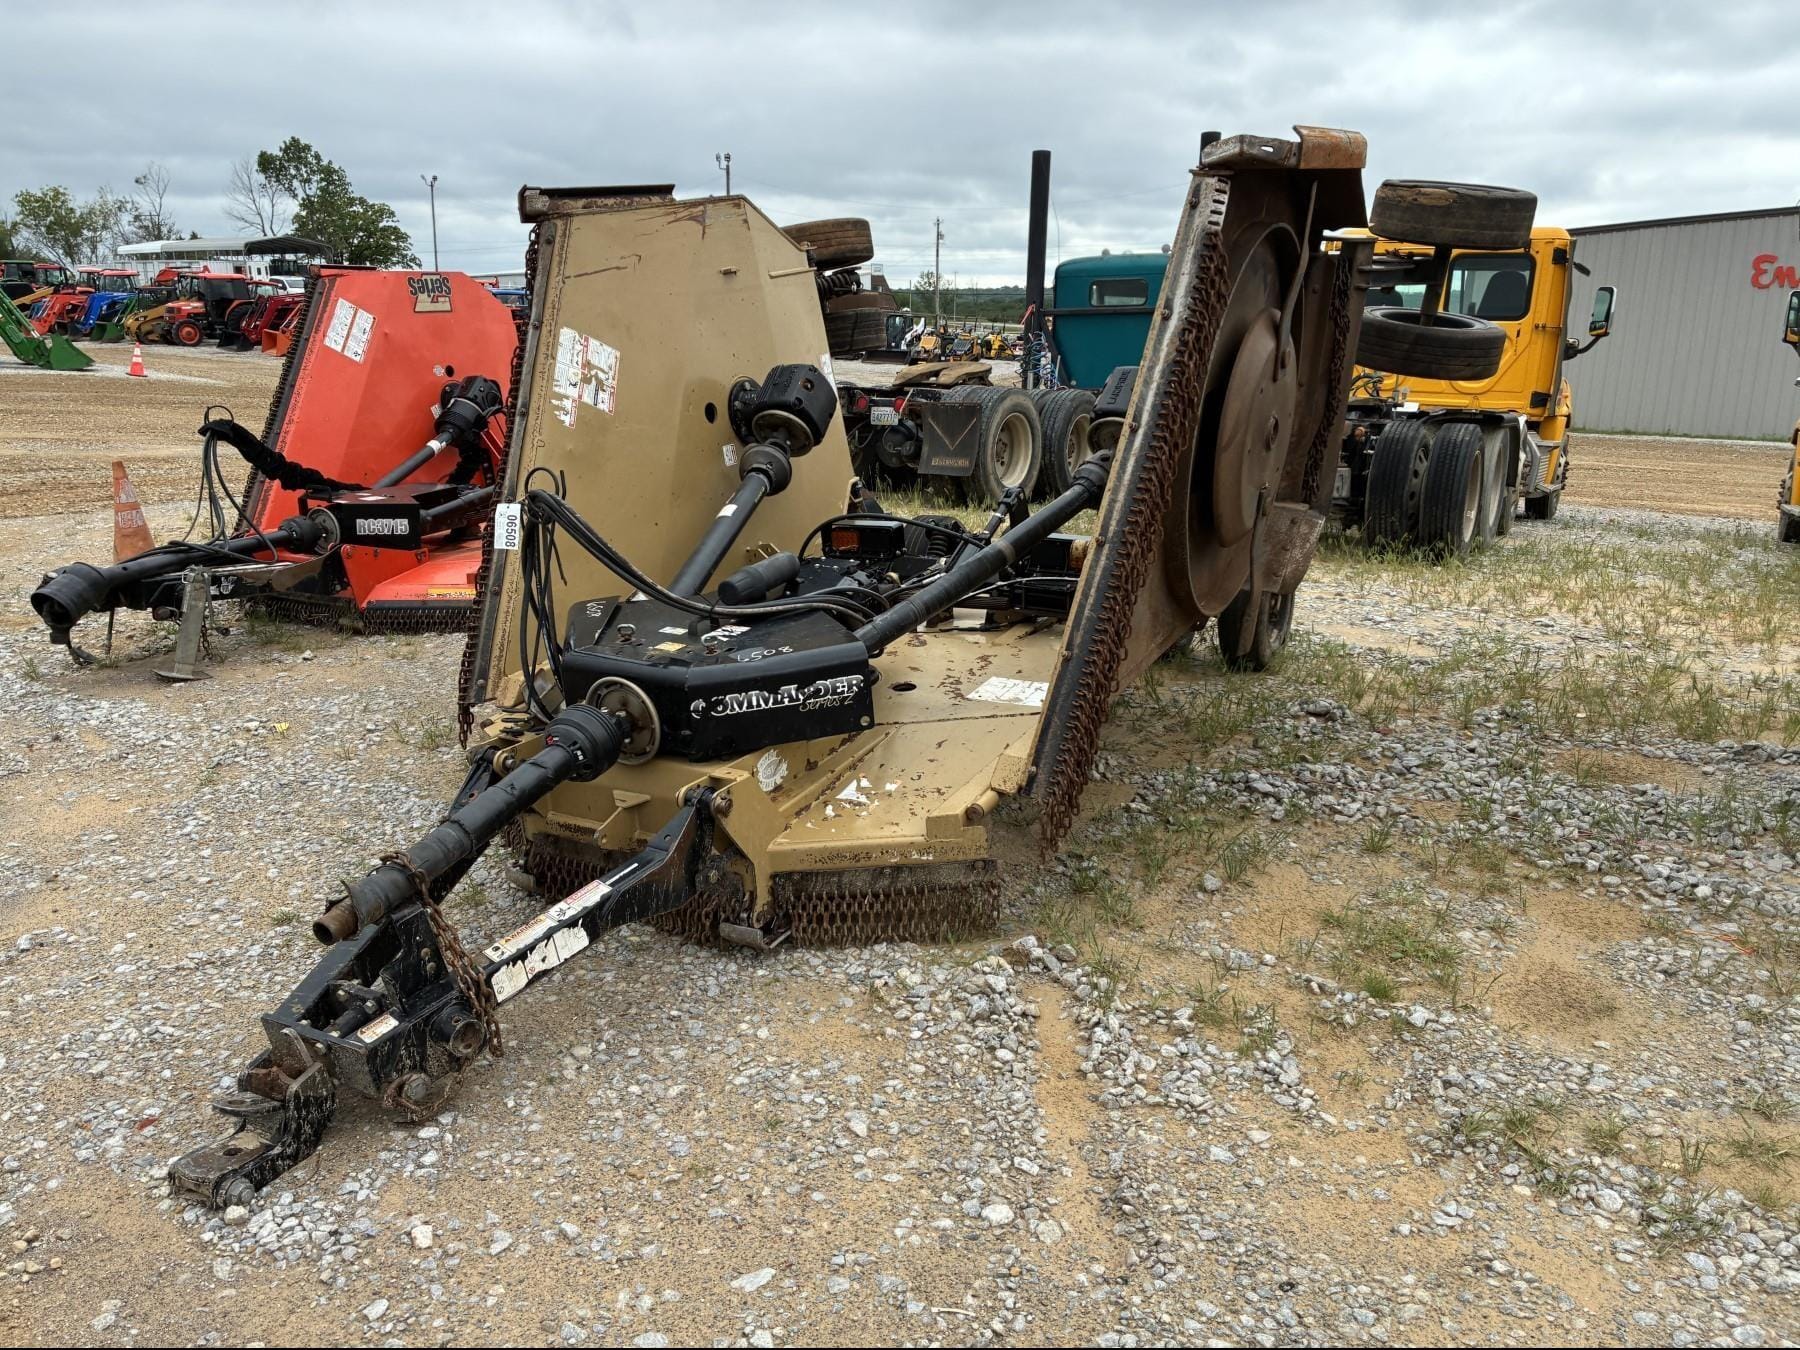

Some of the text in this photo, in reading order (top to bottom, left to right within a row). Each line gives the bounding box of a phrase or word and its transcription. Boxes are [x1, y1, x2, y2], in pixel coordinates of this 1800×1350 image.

[1751, 254, 1800, 289] En
[356, 518, 409, 535] RC3715
[504, 514, 518, 548] 06508
[737, 645, 793, 661] 6508
[510, 917, 544, 940] WARNING
